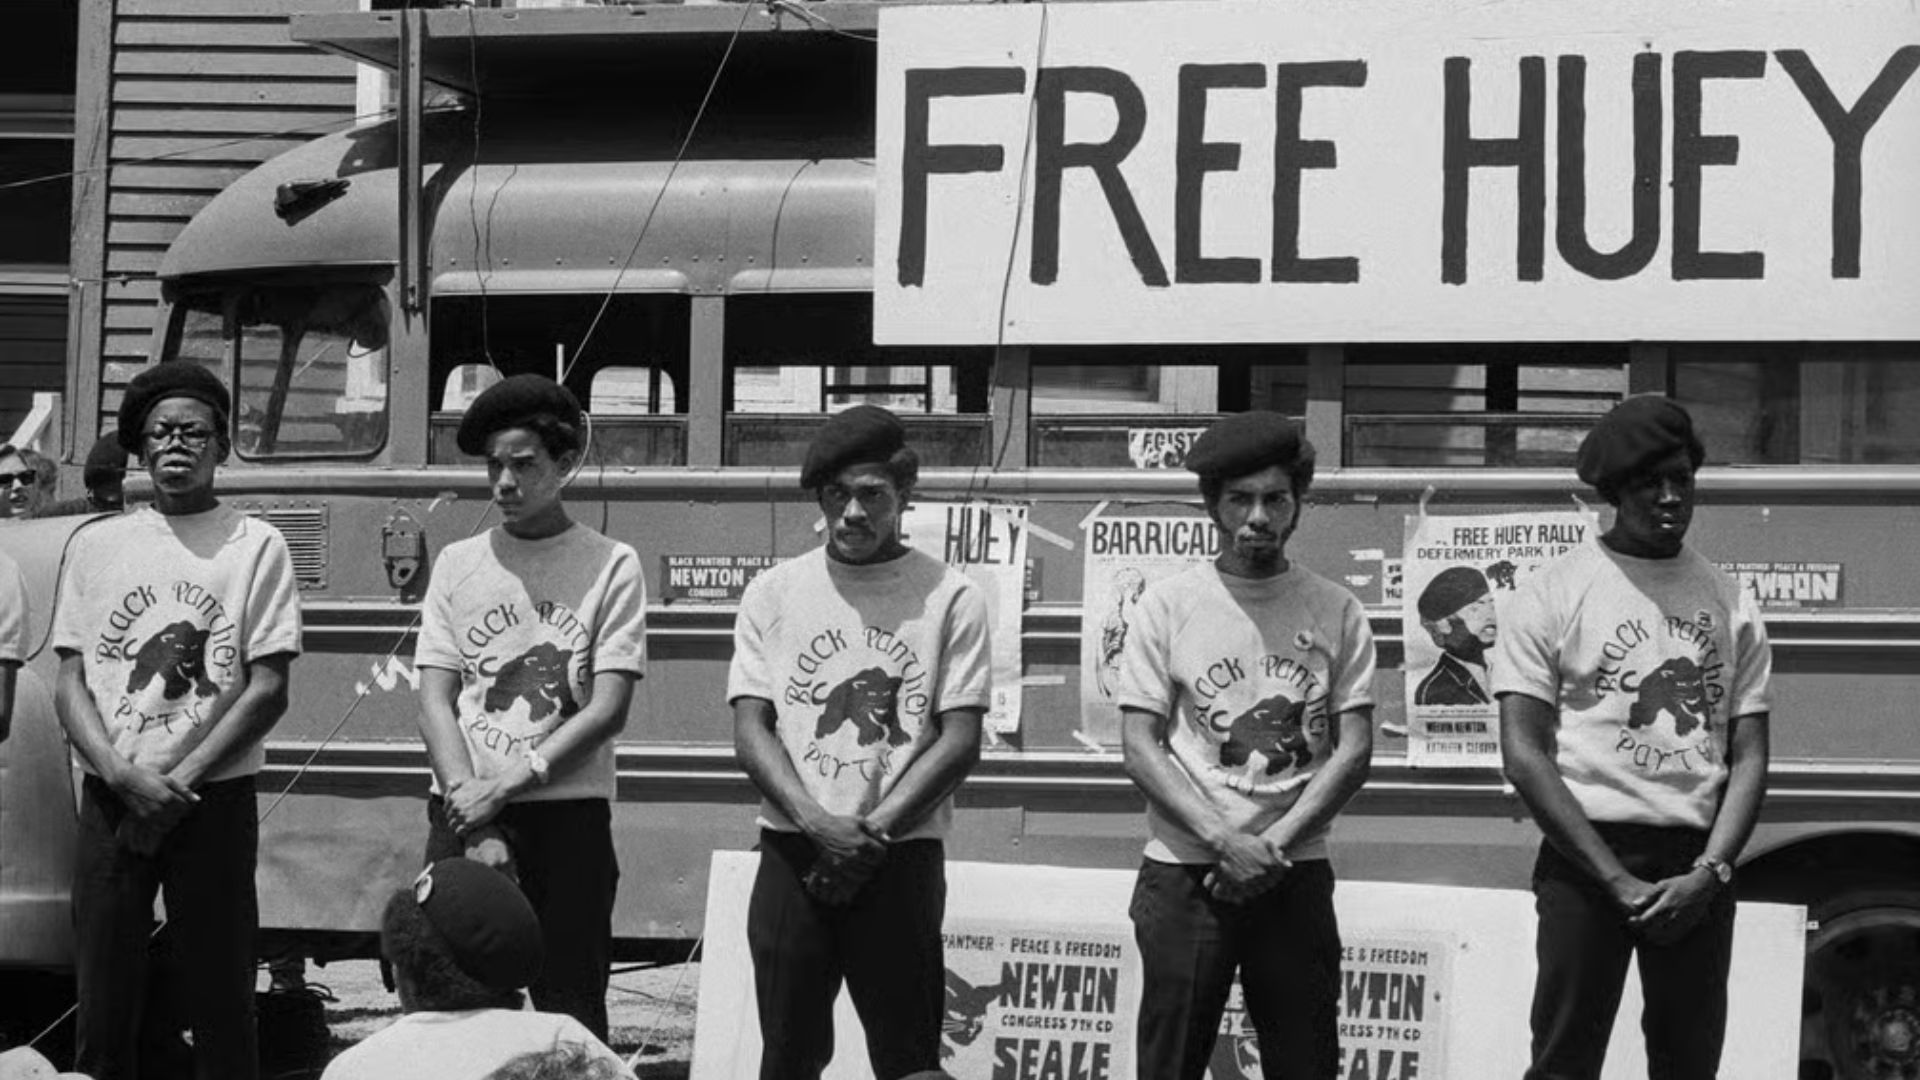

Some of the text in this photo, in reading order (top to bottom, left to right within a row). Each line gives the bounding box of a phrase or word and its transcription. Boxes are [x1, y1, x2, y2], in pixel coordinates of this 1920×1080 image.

[898, 45, 1920, 288] FREE HUEY
[945, 506, 1024, 564] HUEY
[1453, 524, 1585, 546] FREE HUEY RALLY
[1417, 547, 1502, 560] DEFERMERY
[1507, 546, 1543, 558] PARK
[670, 568, 744, 586] NEWTON
[1728, 572, 1839, 600] EWTON
[1011, 937, 1049, 955] PEACE
[1055, 941, 1062, 956] &
[1065, 941, 1121, 958] FREEDOM
[1370, 948, 1428, 966] FREEDOM
[999, 962, 1118, 1014] NEWTON
[1002, 1014, 1066, 1030] CONGRESS
[1096, 1020, 1114, 1033] CD
[1403, 1027, 1421, 1041] CD
[992, 1037, 1111, 1080] SEALE
